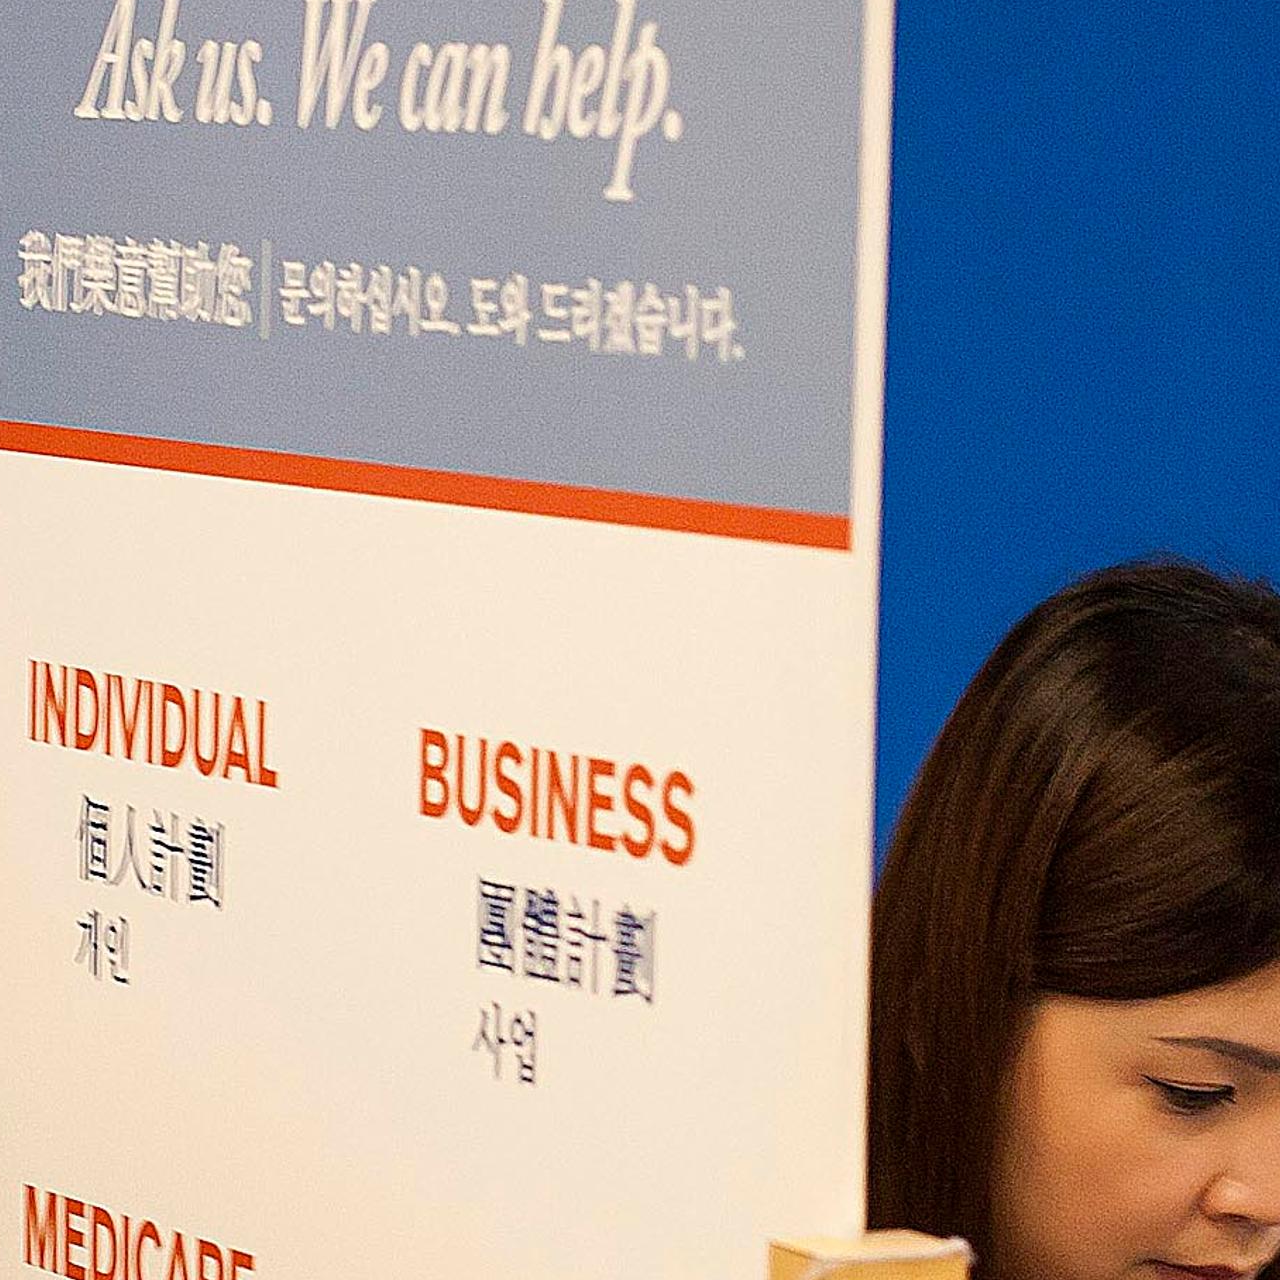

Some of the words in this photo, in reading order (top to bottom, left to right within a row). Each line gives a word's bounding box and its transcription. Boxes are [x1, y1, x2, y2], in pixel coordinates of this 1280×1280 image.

[195, 38, 273, 127] us.
[397, 40, 513, 137] can
[465, 272, 535, 347] 도와
[536, 276, 748, 364] 드리겠습니다.
[29, 658, 280, 788] INDIVIDUAL
[418, 727, 697, 868] BUSINESS
[75, 794, 224, 908] 個人計劃
[74, 908, 131, 986] 개인
[477, 874, 655, 1005] 團體計劃
[471, 1000, 537, 1087] 사업
